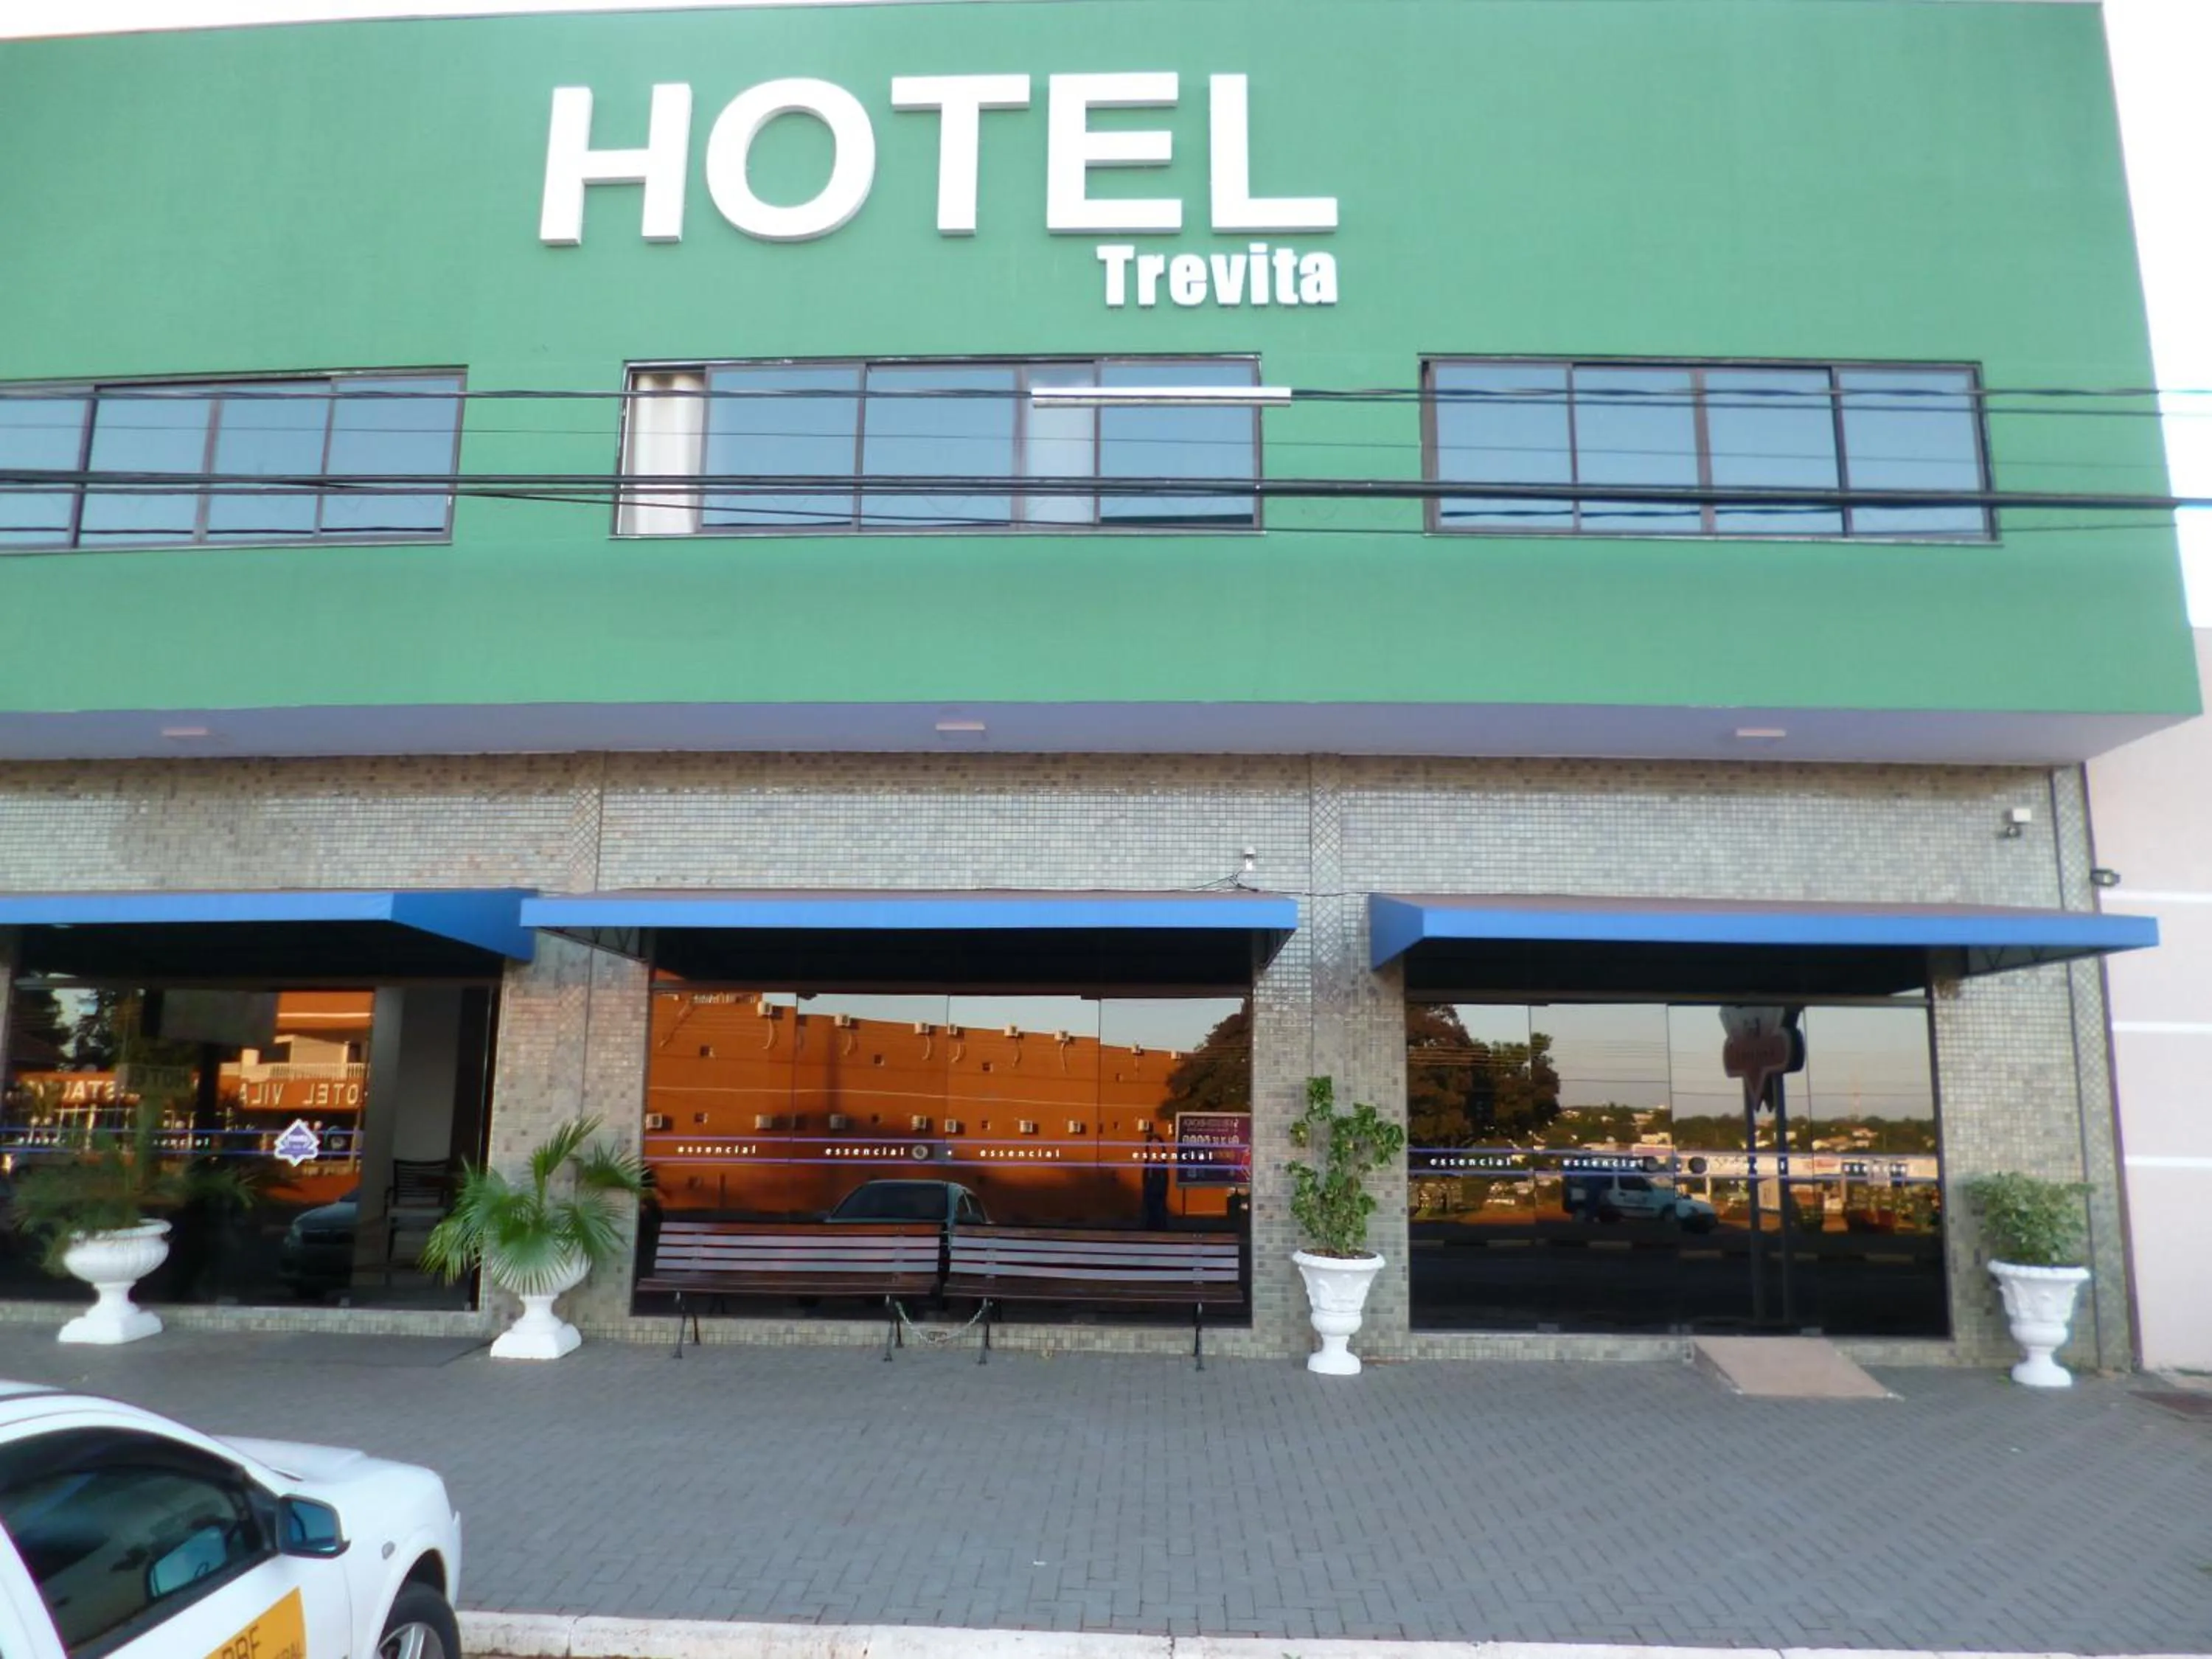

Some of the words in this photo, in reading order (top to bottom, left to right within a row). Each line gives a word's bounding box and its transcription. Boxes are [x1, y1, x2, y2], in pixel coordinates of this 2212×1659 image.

[539, 72, 1338, 246] HOTEL
[1096, 242, 1338, 307] Trevita
[678, 1145, 756, 1154] essencial
[825, 1147, 904, 1155] essencial
[980, 1149, 1060, 1158] essencial
[1132, 1151, 1213, 1160] essencial
[1430, 1157, 1511, 1166] essencial
